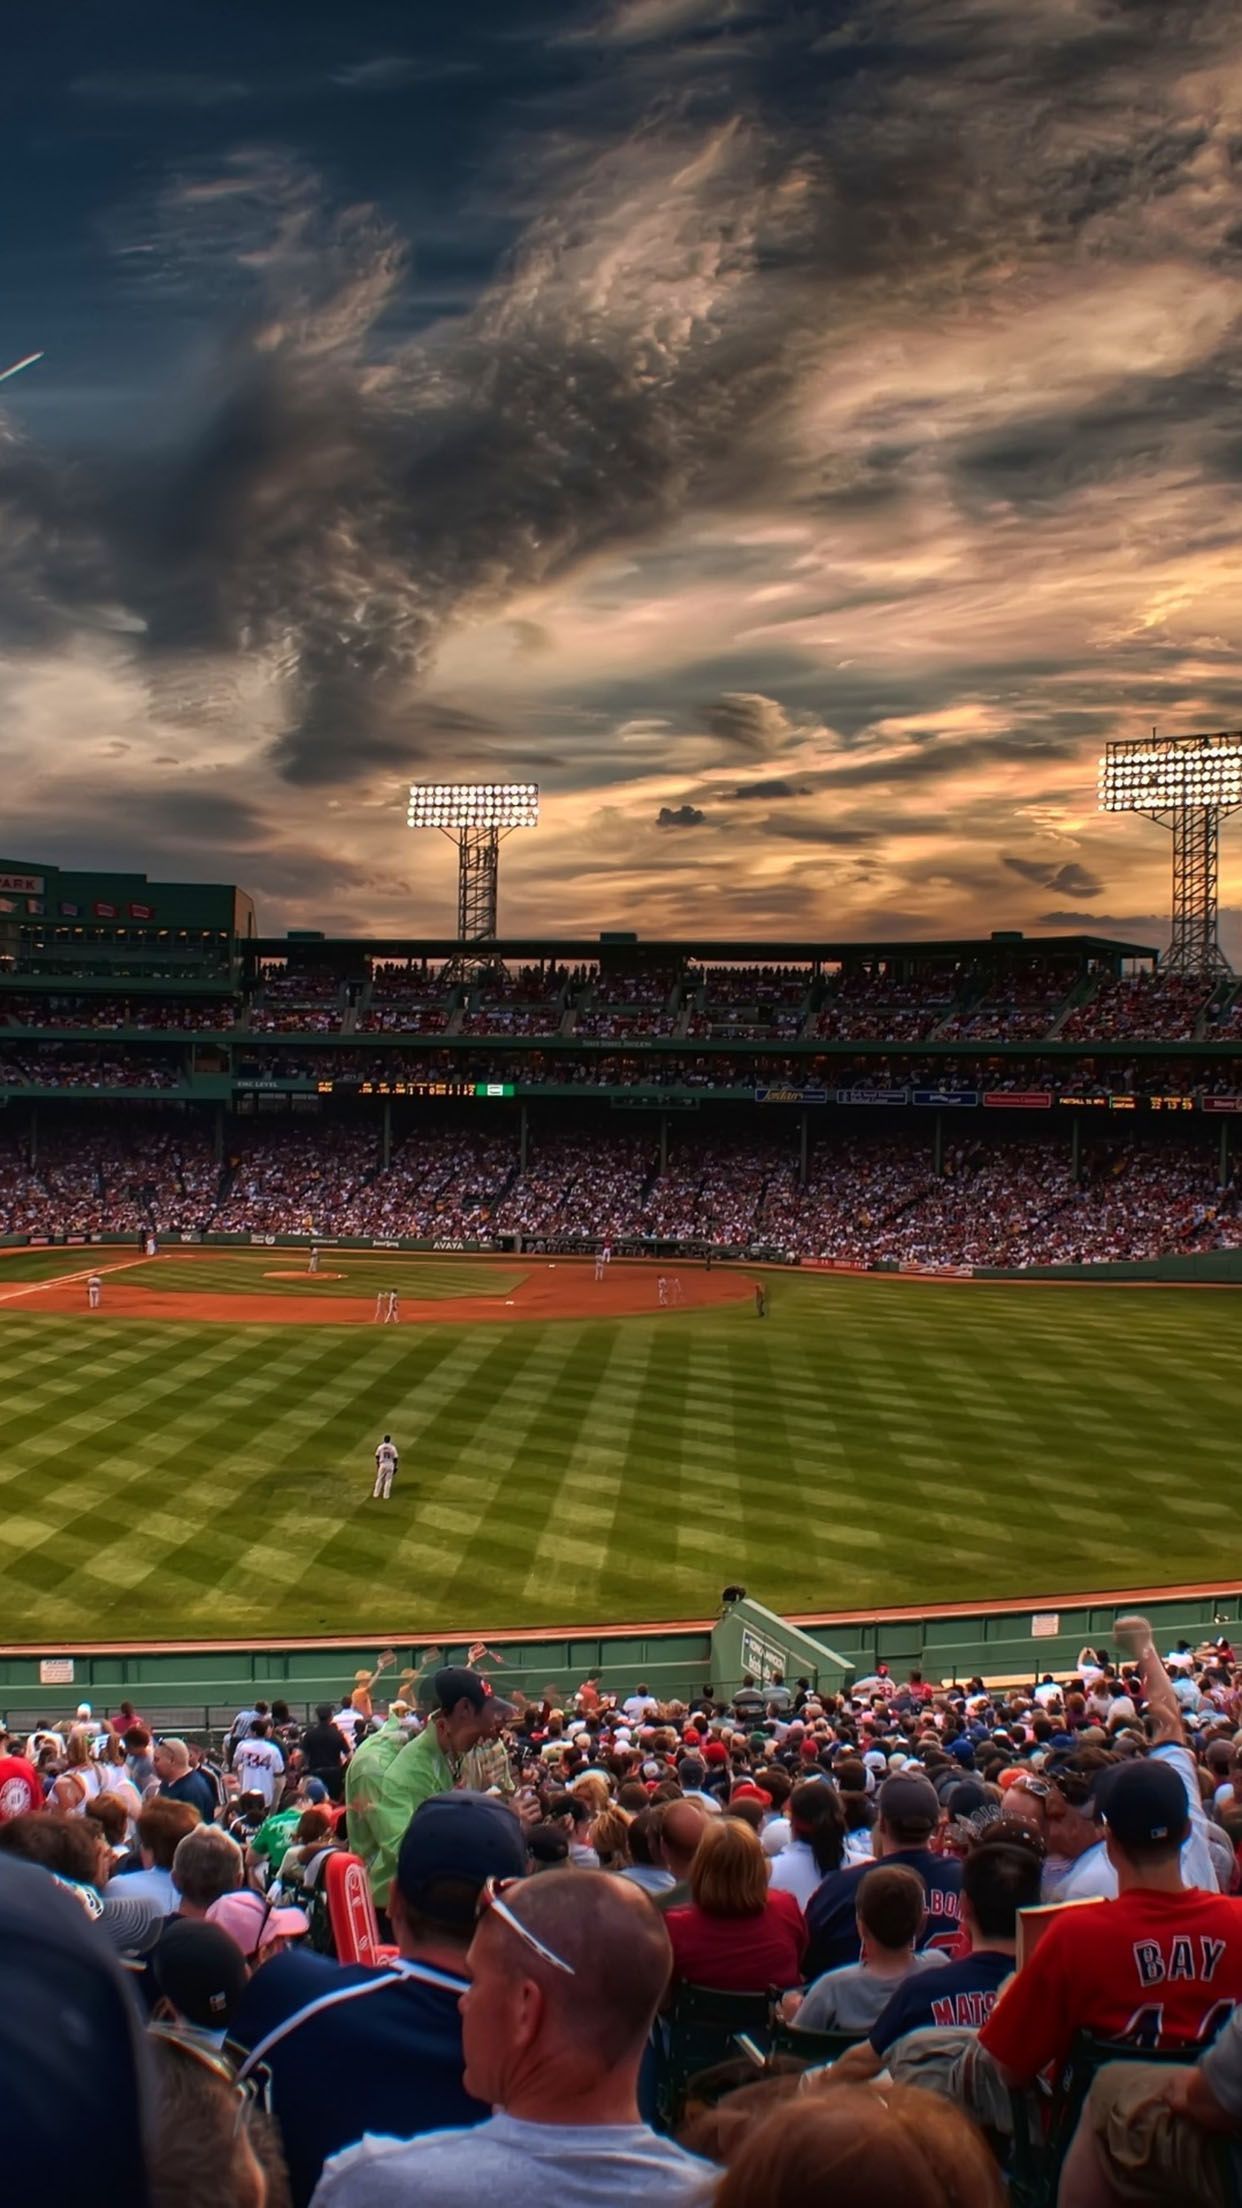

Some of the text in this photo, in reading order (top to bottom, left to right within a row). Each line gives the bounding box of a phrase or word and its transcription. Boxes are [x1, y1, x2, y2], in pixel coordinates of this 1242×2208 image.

[0, 879, 35, 890] ARK
[432, 1241, 465, 1250] AVAYA
[1132, 1935, 1227, 1988] BAY
